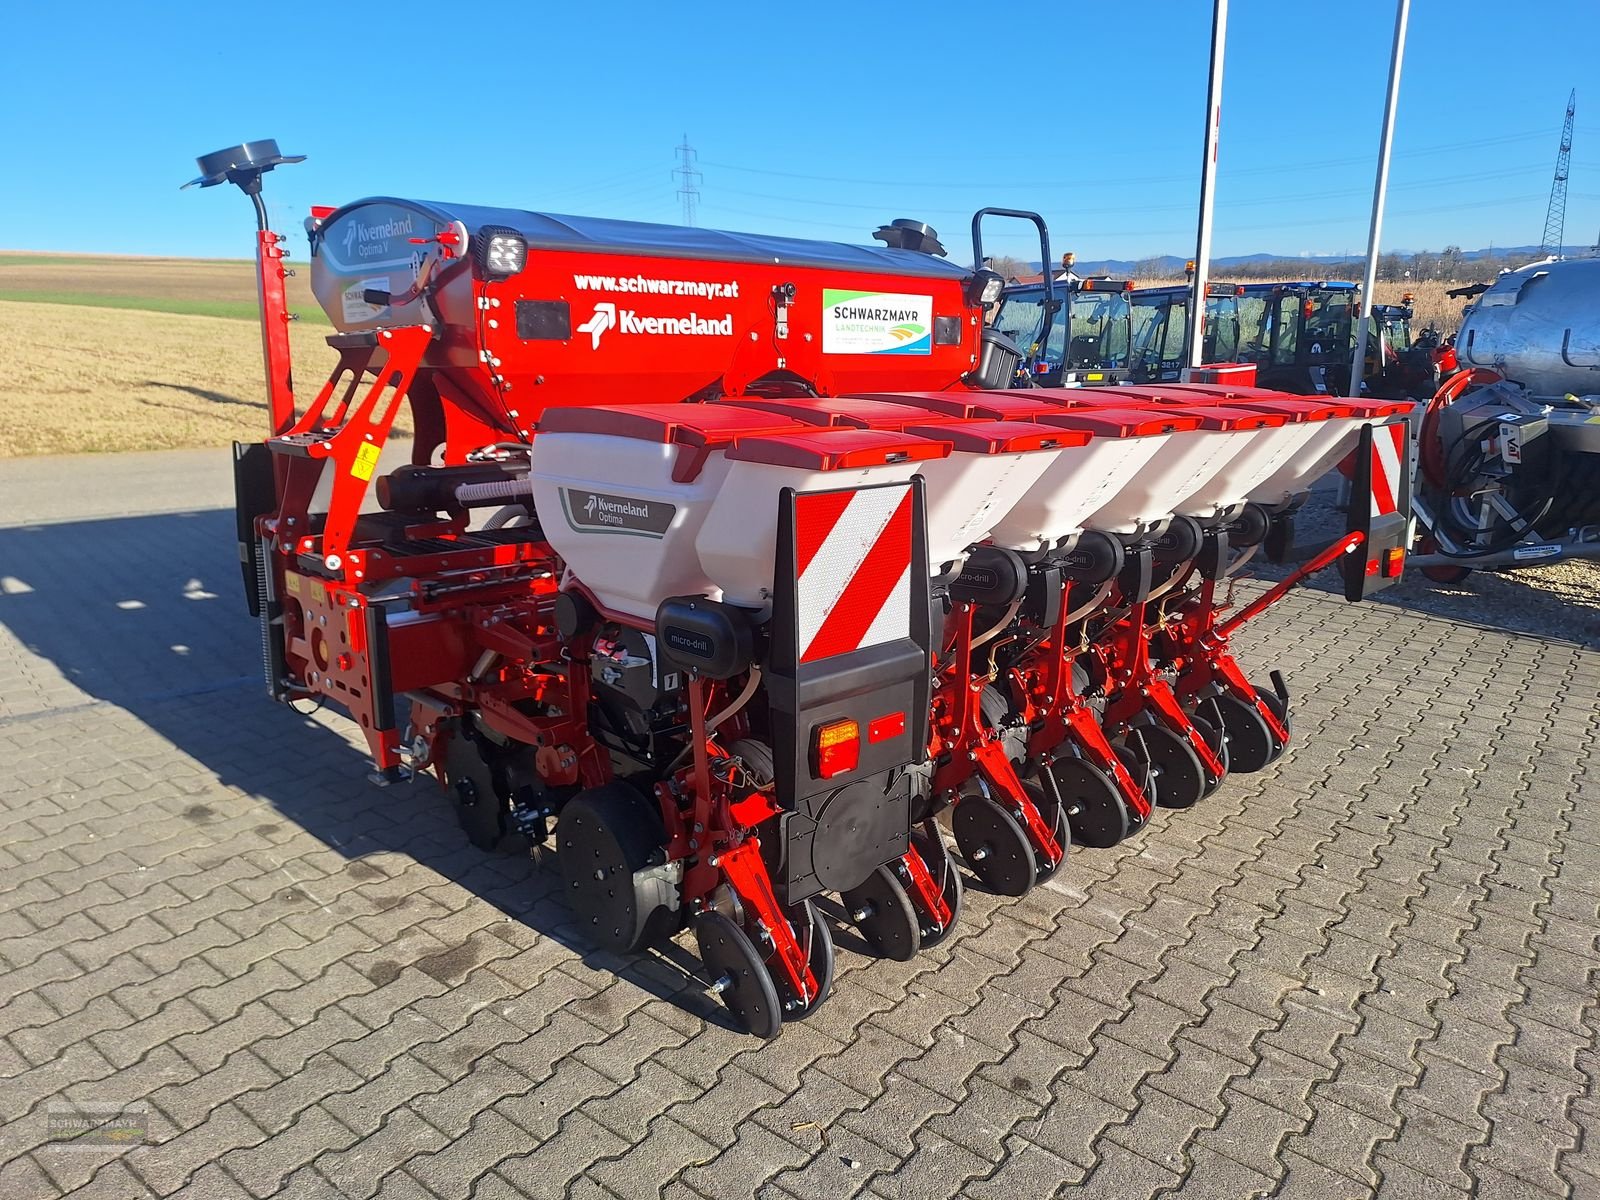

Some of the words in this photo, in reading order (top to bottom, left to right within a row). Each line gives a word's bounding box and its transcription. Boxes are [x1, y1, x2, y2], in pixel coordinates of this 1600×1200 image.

[358, 214, 413, 242] Kverneland
[358, 243, 383, 258] Optima
[383, 241, 390, 253] V
[573, 274, 739, 300] www.schwarzmayr.at
[834, 306, 918, 321] SCHWARZMAYR
[619, 310, 733, 336] Kverneland
[835, 324, 886, 333] LANDTECHNIK
[598, 497, 649, 518] Kverneland
[598, 511, 623, 525] Optima
[959, 573, 990, 583] cro-drill
[671, 634, 708, 652] micro-drill
[668, 675, 675, 689] 1
